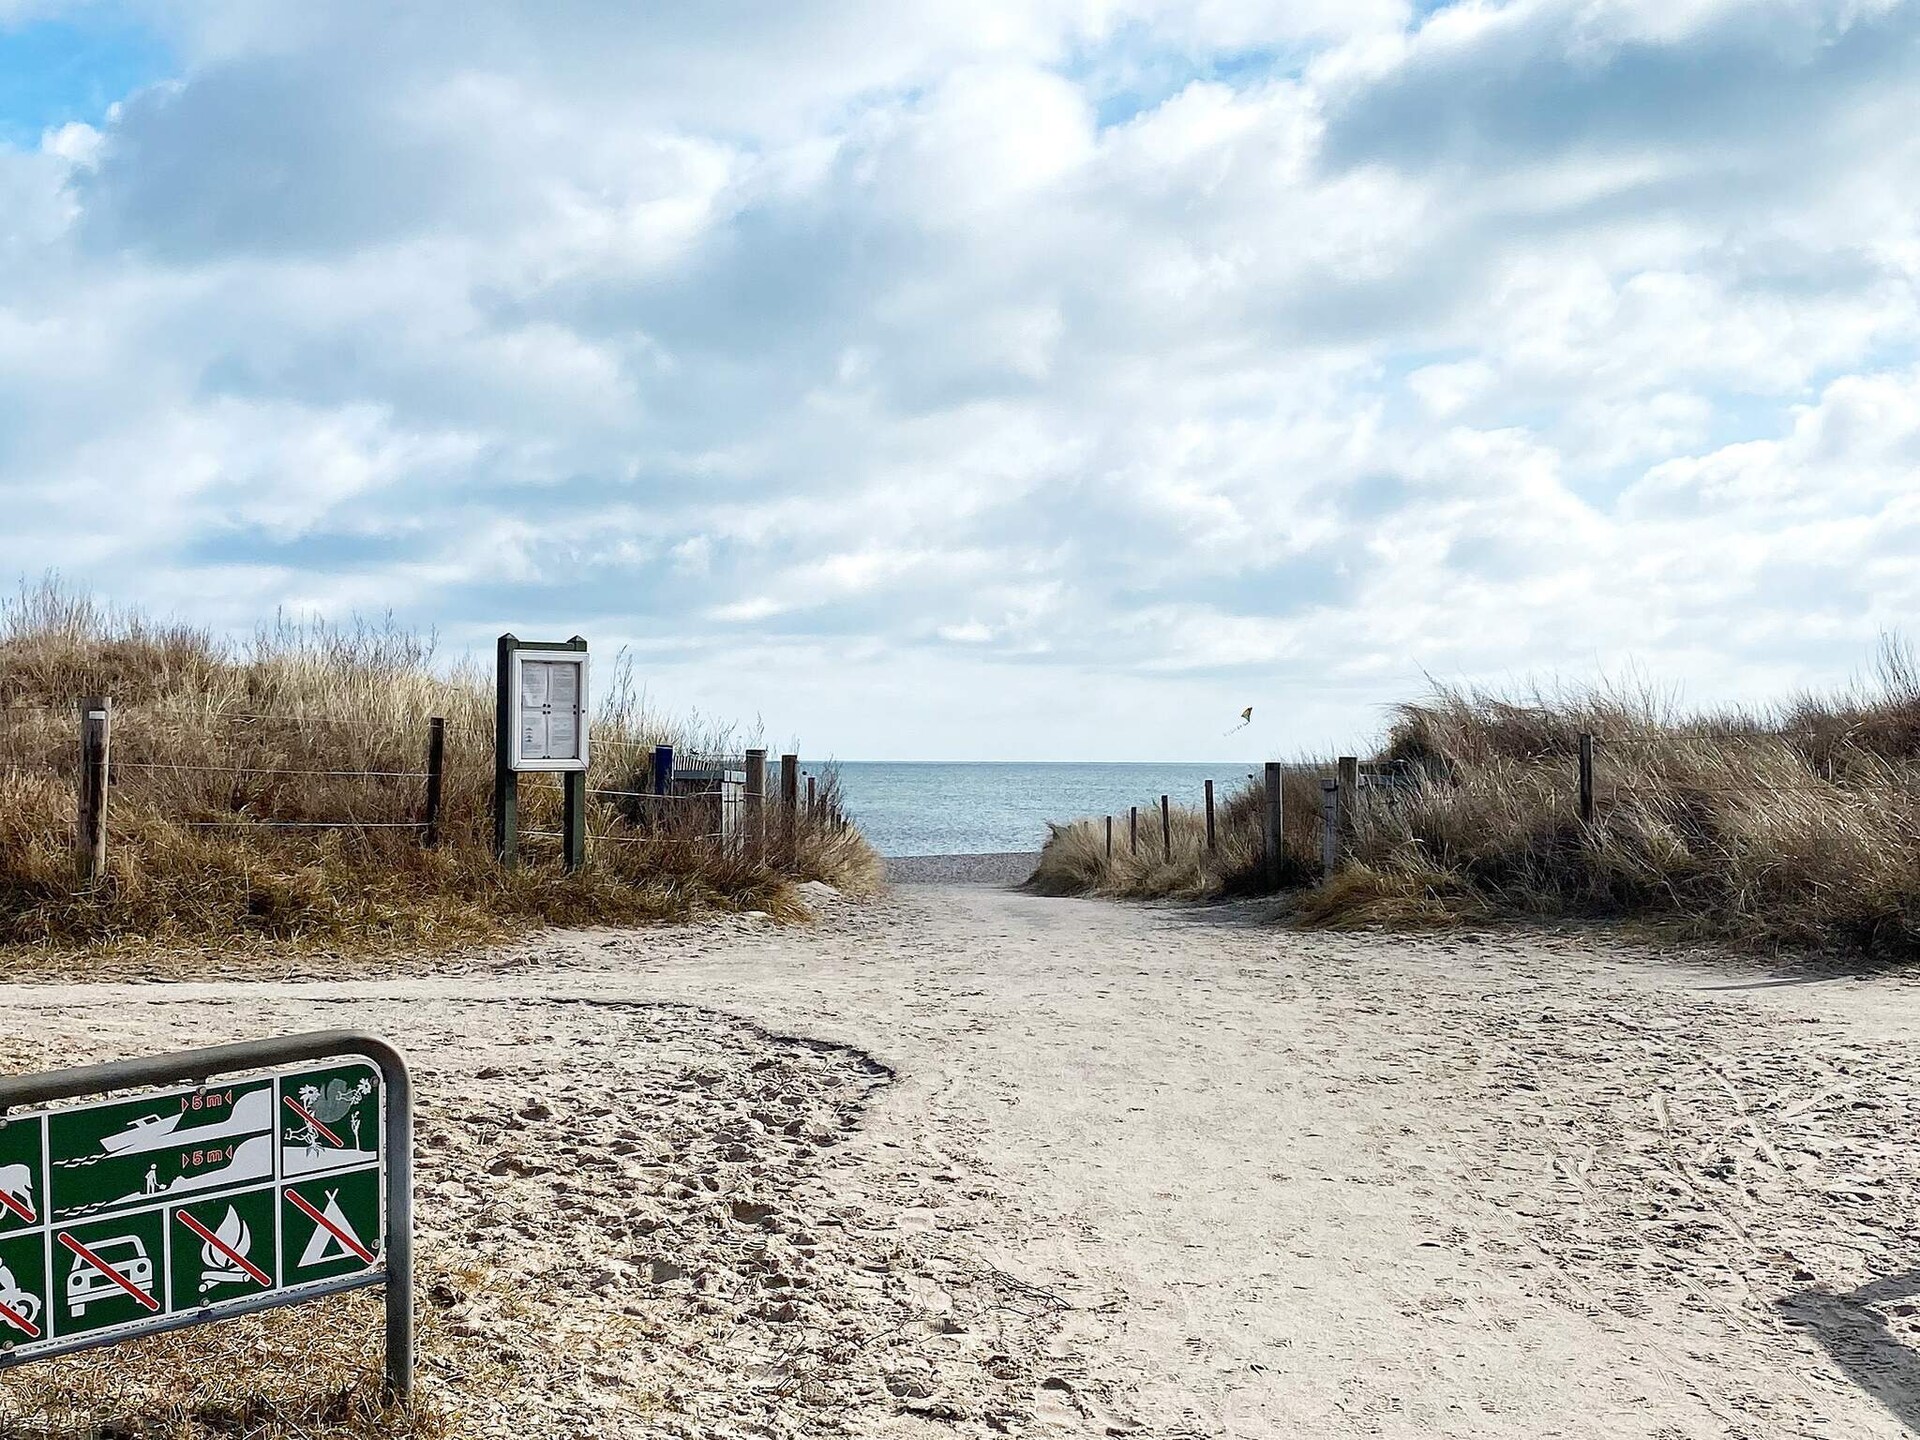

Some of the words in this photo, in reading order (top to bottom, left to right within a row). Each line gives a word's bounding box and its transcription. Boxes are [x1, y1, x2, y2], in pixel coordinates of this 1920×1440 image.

[192, 1095, 202, 1110] 5
[207, 1094, 222, 1107] m
[192, 1150, 203, 1165] 5
[207, 1149, 222, 1163] m
